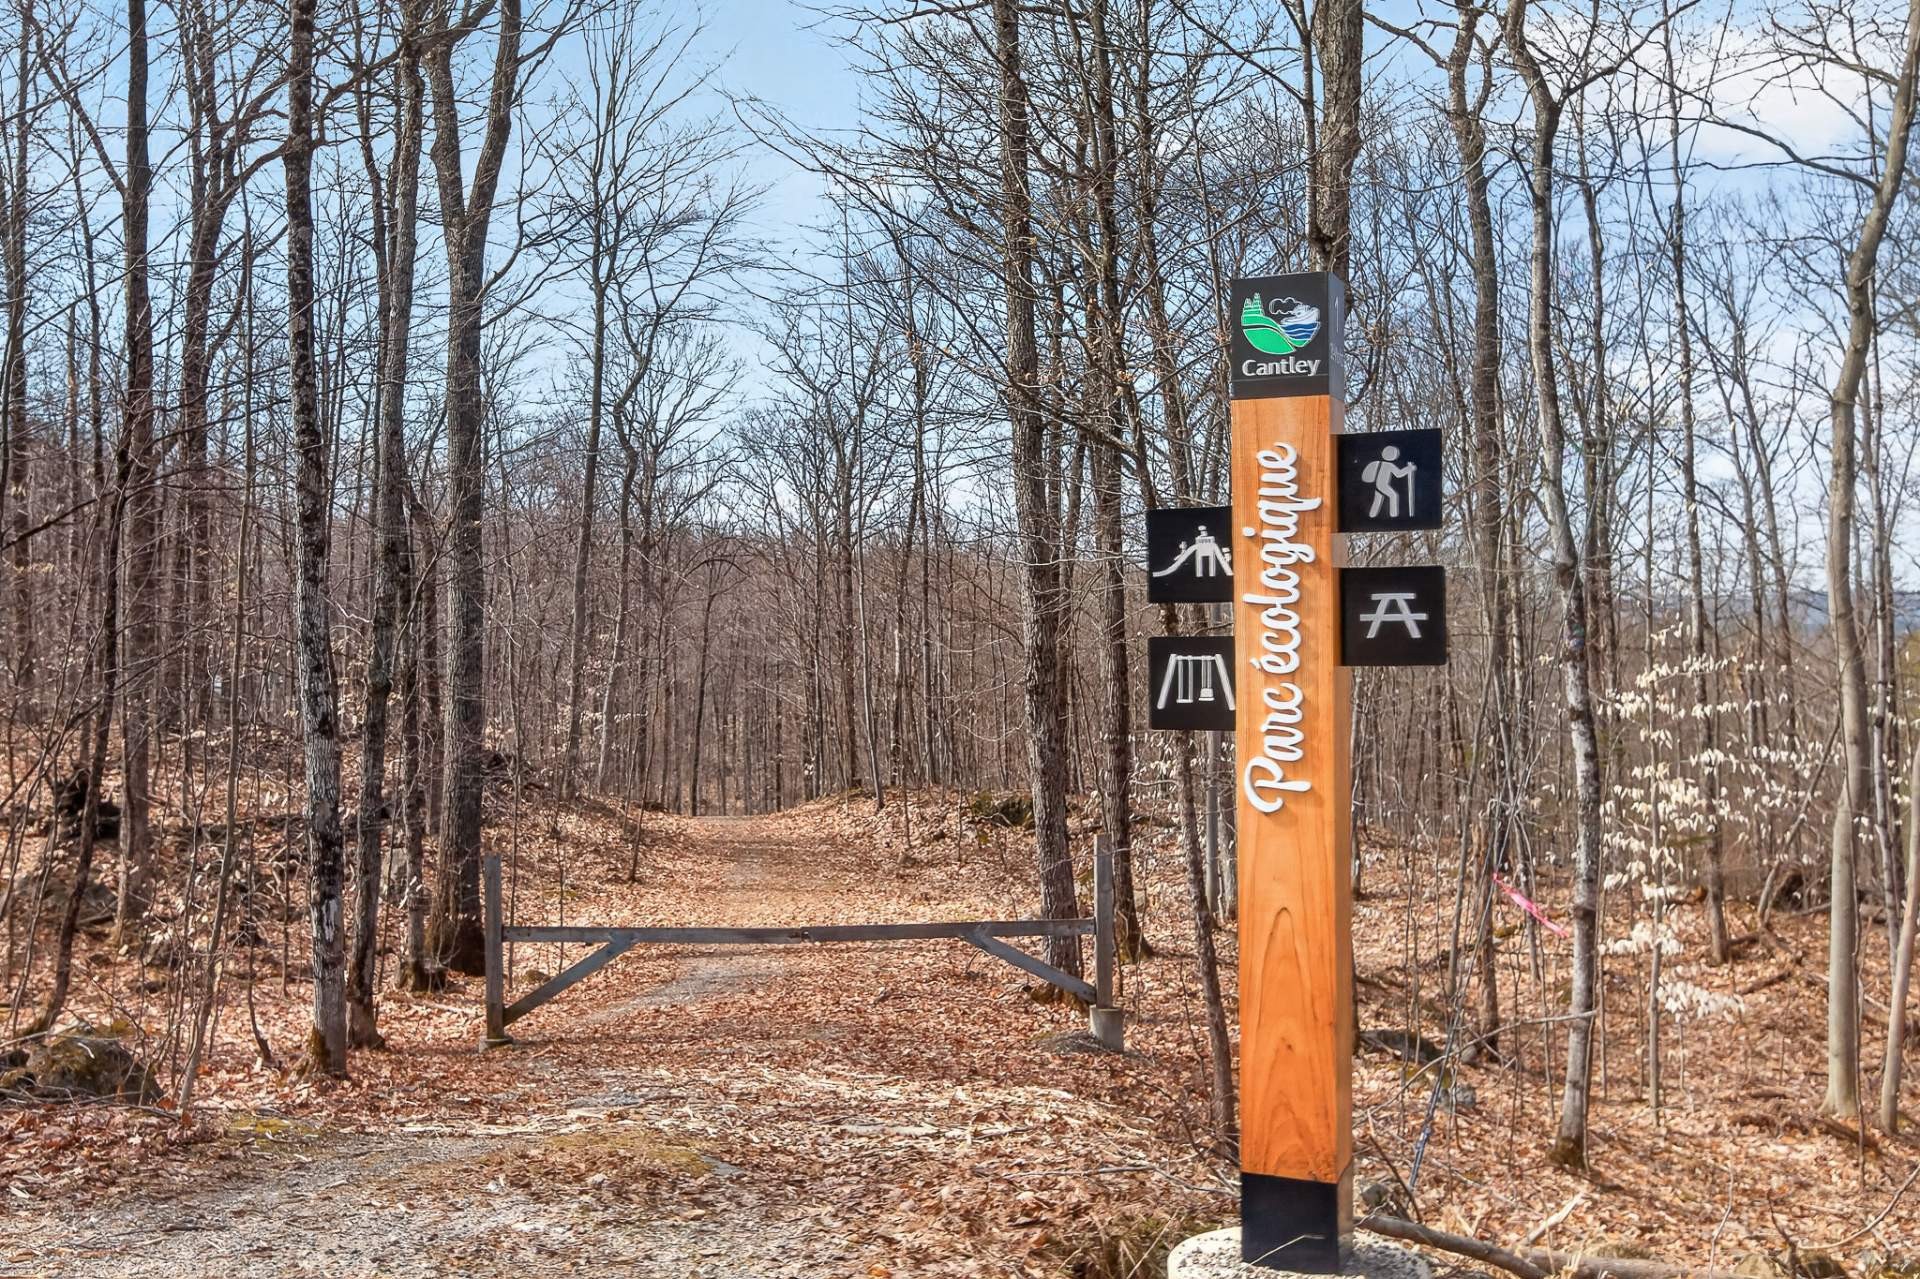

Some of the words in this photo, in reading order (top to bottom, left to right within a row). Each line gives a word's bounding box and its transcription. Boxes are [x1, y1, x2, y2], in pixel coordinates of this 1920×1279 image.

[1242, 357, 1320, 376] Cantley
[1243, 443, 1322, 675] écologique
[1245, 682, 1311, 813] Parc
